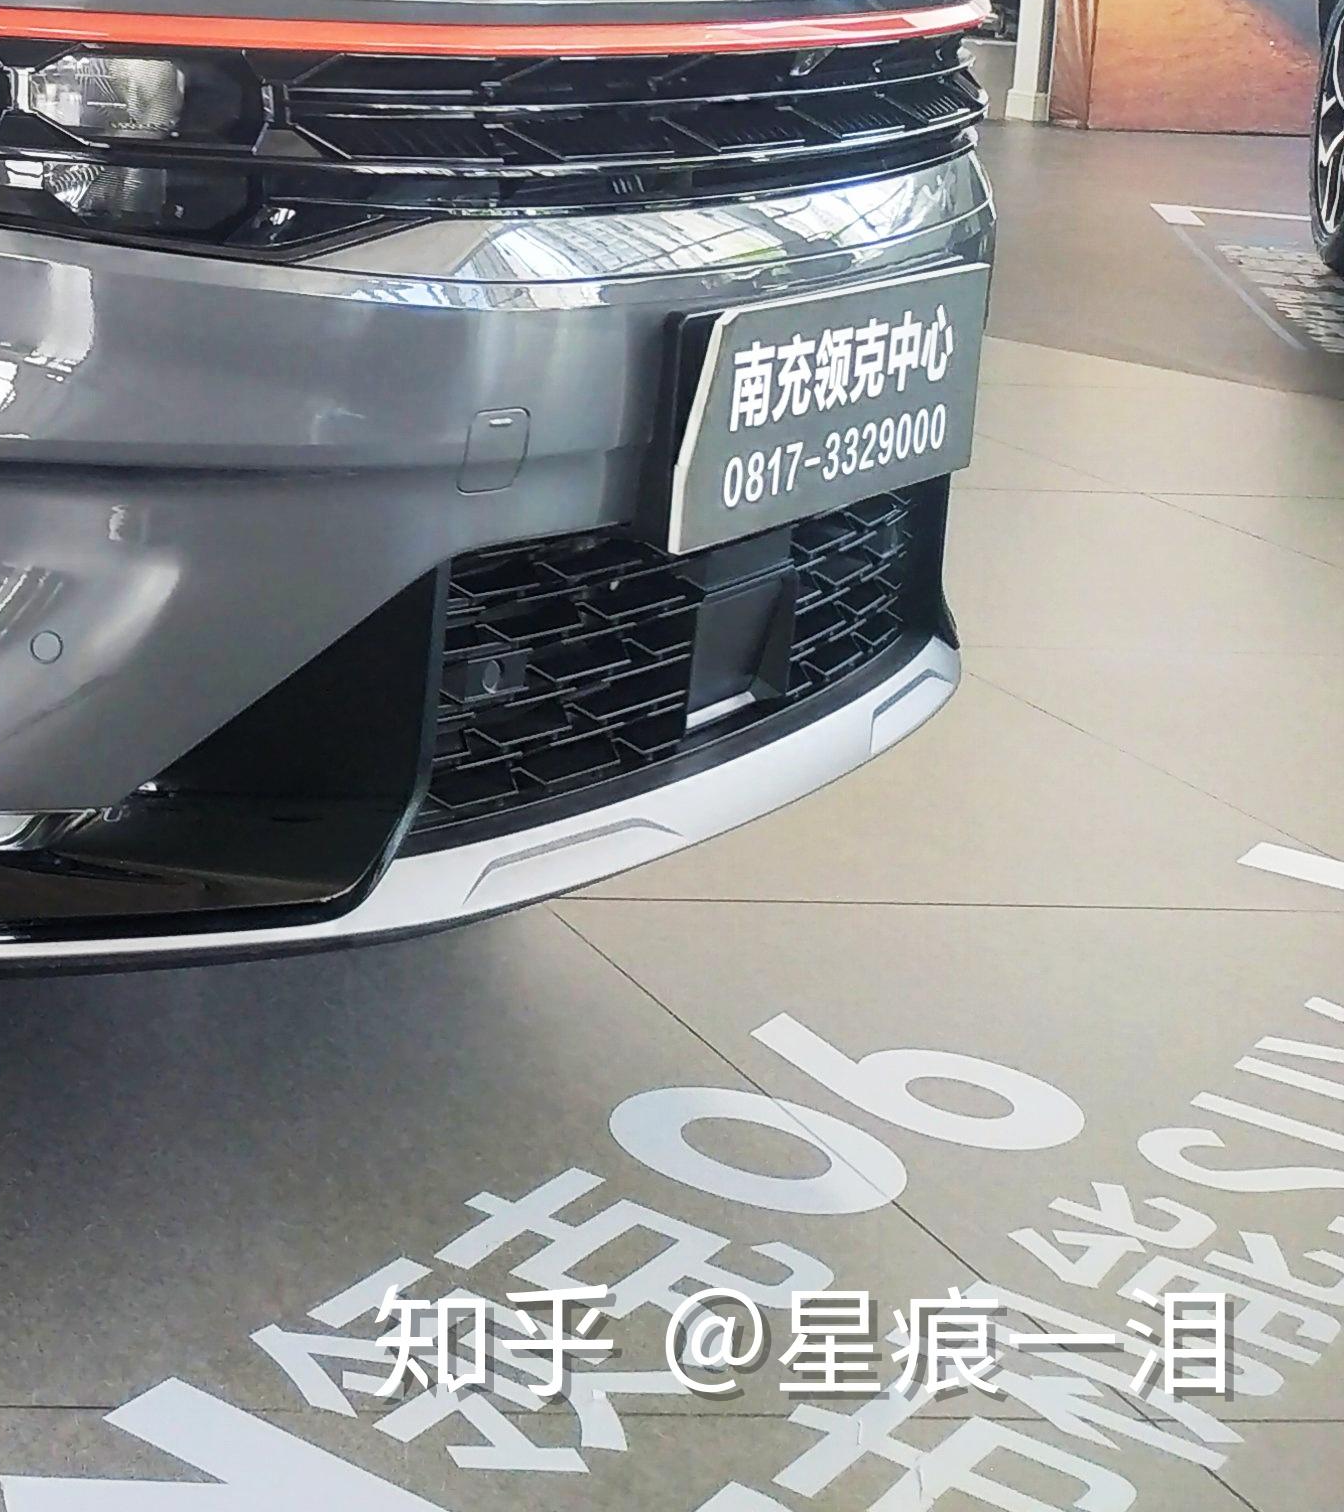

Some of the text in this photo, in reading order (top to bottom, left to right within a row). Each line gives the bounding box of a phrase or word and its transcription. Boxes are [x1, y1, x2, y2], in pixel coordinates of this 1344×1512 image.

[729, 304, 954, 432] 南充领克中心
[723, 403, 946, 509] 0817-3329000
